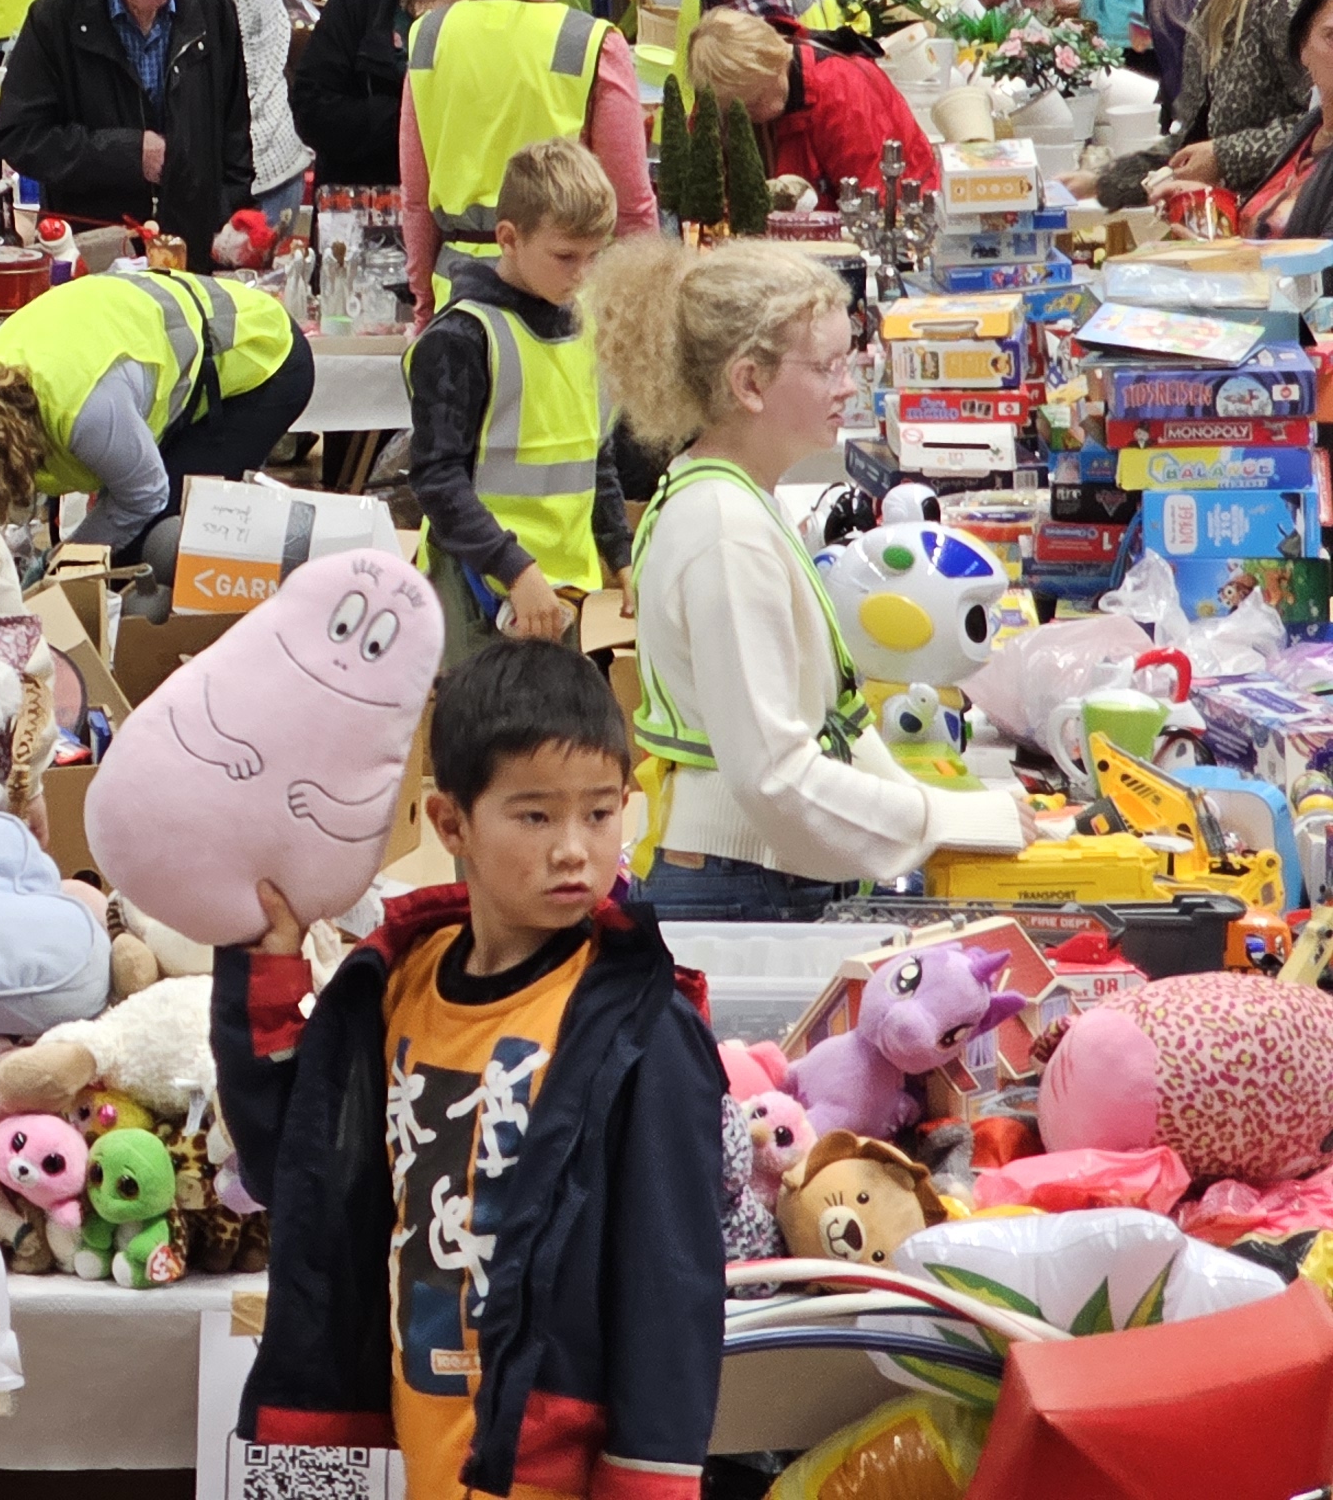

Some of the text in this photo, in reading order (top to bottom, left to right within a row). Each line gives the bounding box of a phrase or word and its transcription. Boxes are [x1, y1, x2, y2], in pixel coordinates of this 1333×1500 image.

[1167, 424, 1250, 440] MONOPOLY
[1017, 889, 1077, 901] TRANSPORT
[1030, 915, 1091, 929] FIRE DEPT
[1094, 978, 1119, 997] 98
